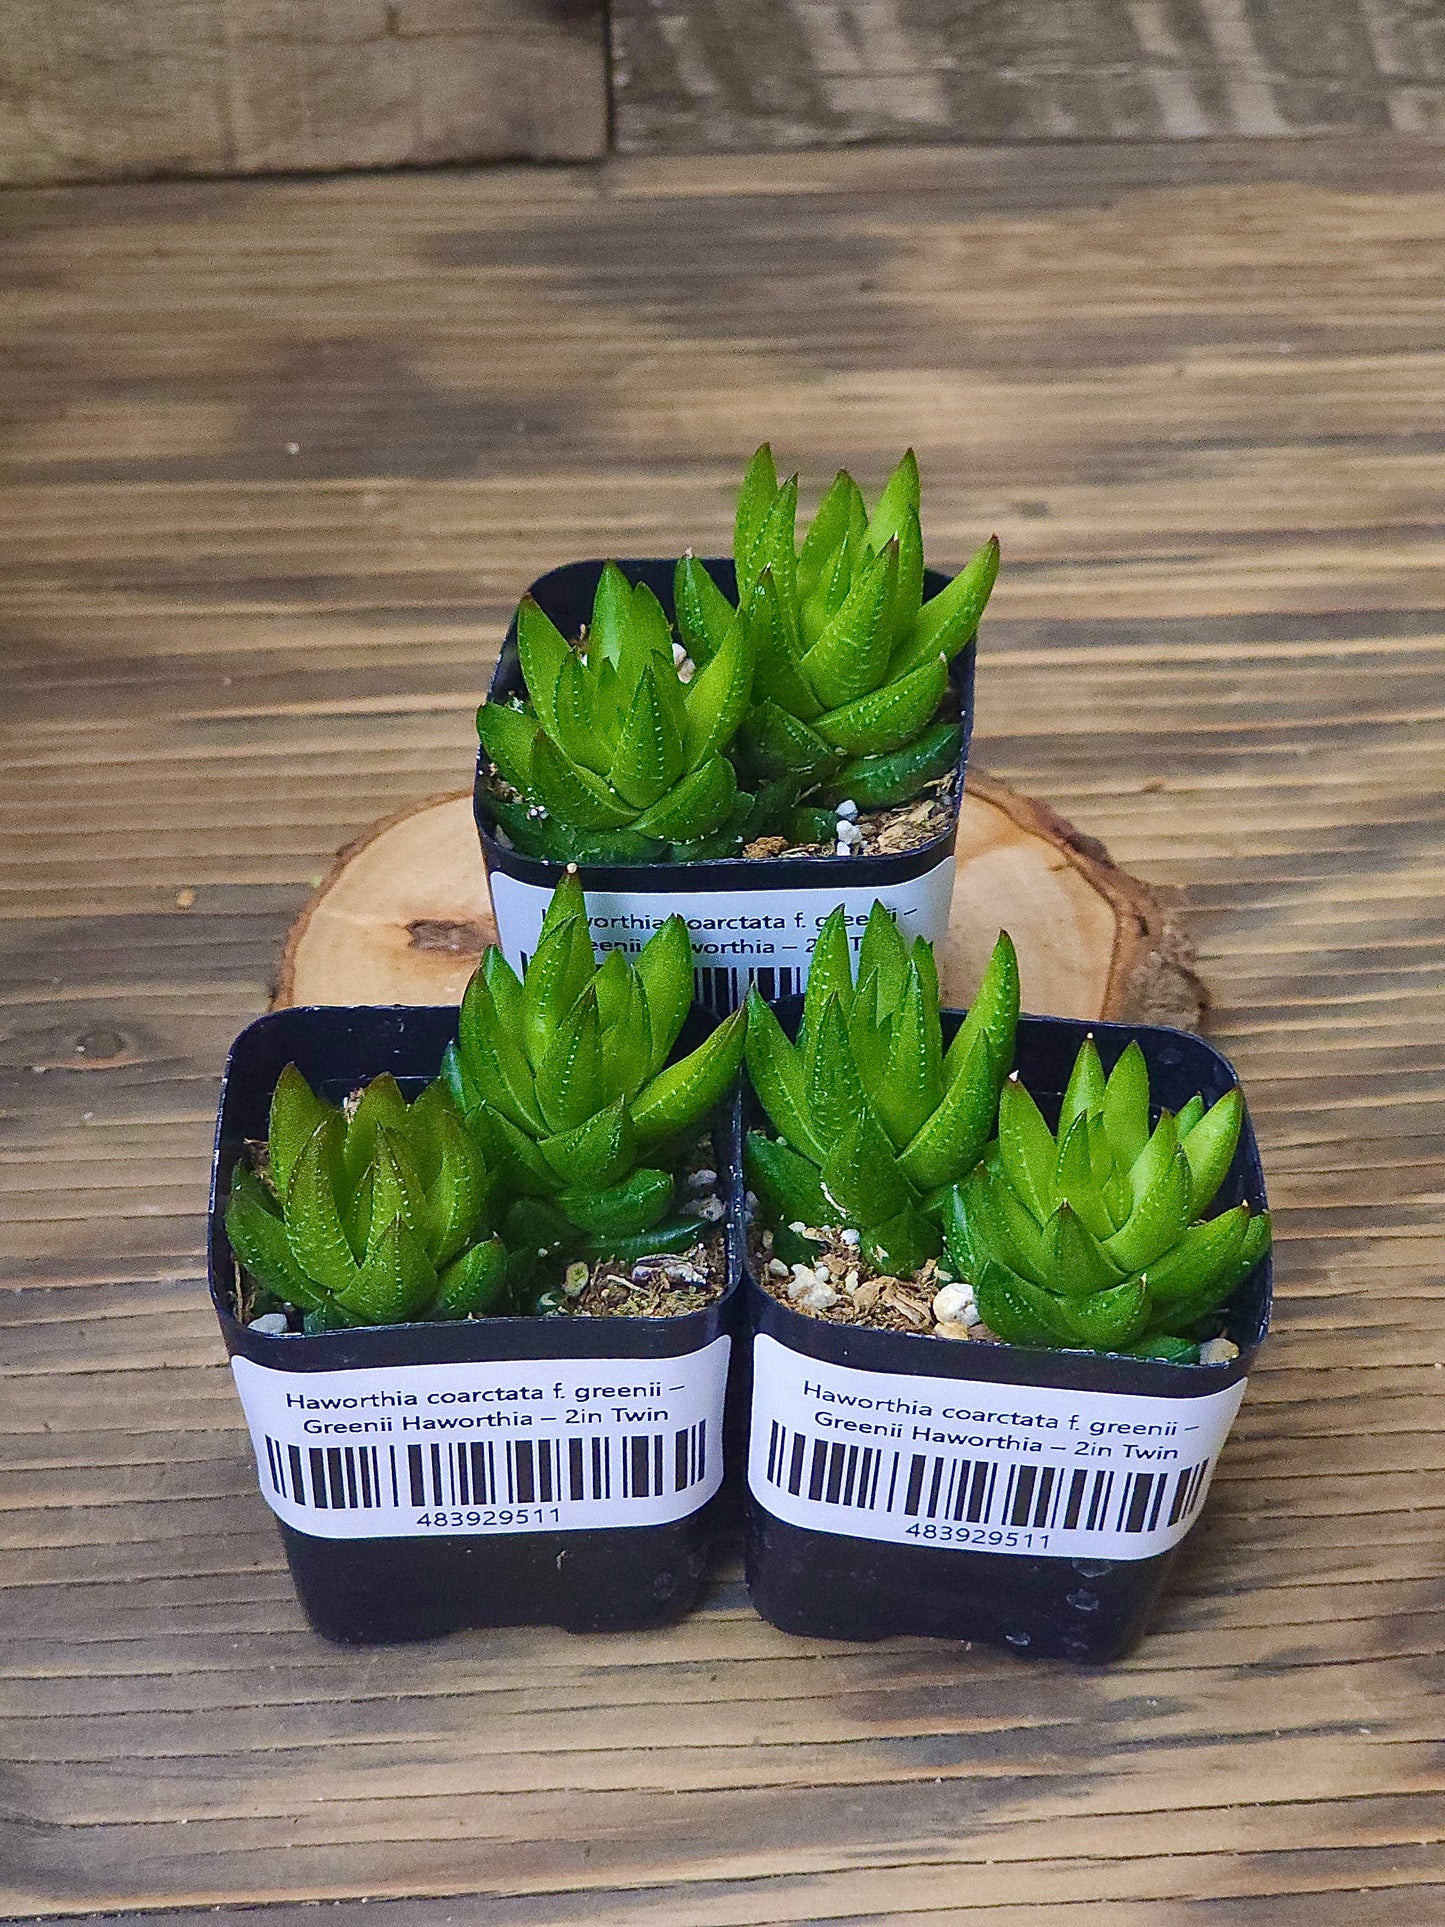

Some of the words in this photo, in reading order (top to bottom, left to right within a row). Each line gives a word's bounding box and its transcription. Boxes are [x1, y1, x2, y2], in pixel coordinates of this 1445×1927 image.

[542, 908, 663, 930] orthia
[686, 912, 786, 931] oarctata
[794, 911, 807, 929] f.
[591, 938, 641, 953] eenii
[691, 938, 776, 955] worthia
[285, 1389, 418, 1411] Haworthia
[426, 1385, 545, 1406] coarctata
[553, 1382, 567, 1401] f.
[575, 1380, 662, 1404] greenii
[803, 1380, 932, 1418] Haworthia
[942, 1405, 1058, 1430] coarctata
[1069, 1414, 1080, 1431] f.
[1089, 1417, 1178, 1440] greenii
[303, 1415, 393, 1436] Greenii
[402, 1410, 534, 1432] Haworthia
[565, 1408, 603, 1425] 2in
[611, 1405, 669, 1424] Twin
[814, 1411, 904, 1440] Greenii
[912, 1425, 1043, 1453] Haworthia
[1073, 1441, 1112, 1458] 2in
[1122, 1443, 1179, 1461] Twin
[416, 1507, 560, 1528] 483929511
[905, 1521, 1051, 1550] 483929511
